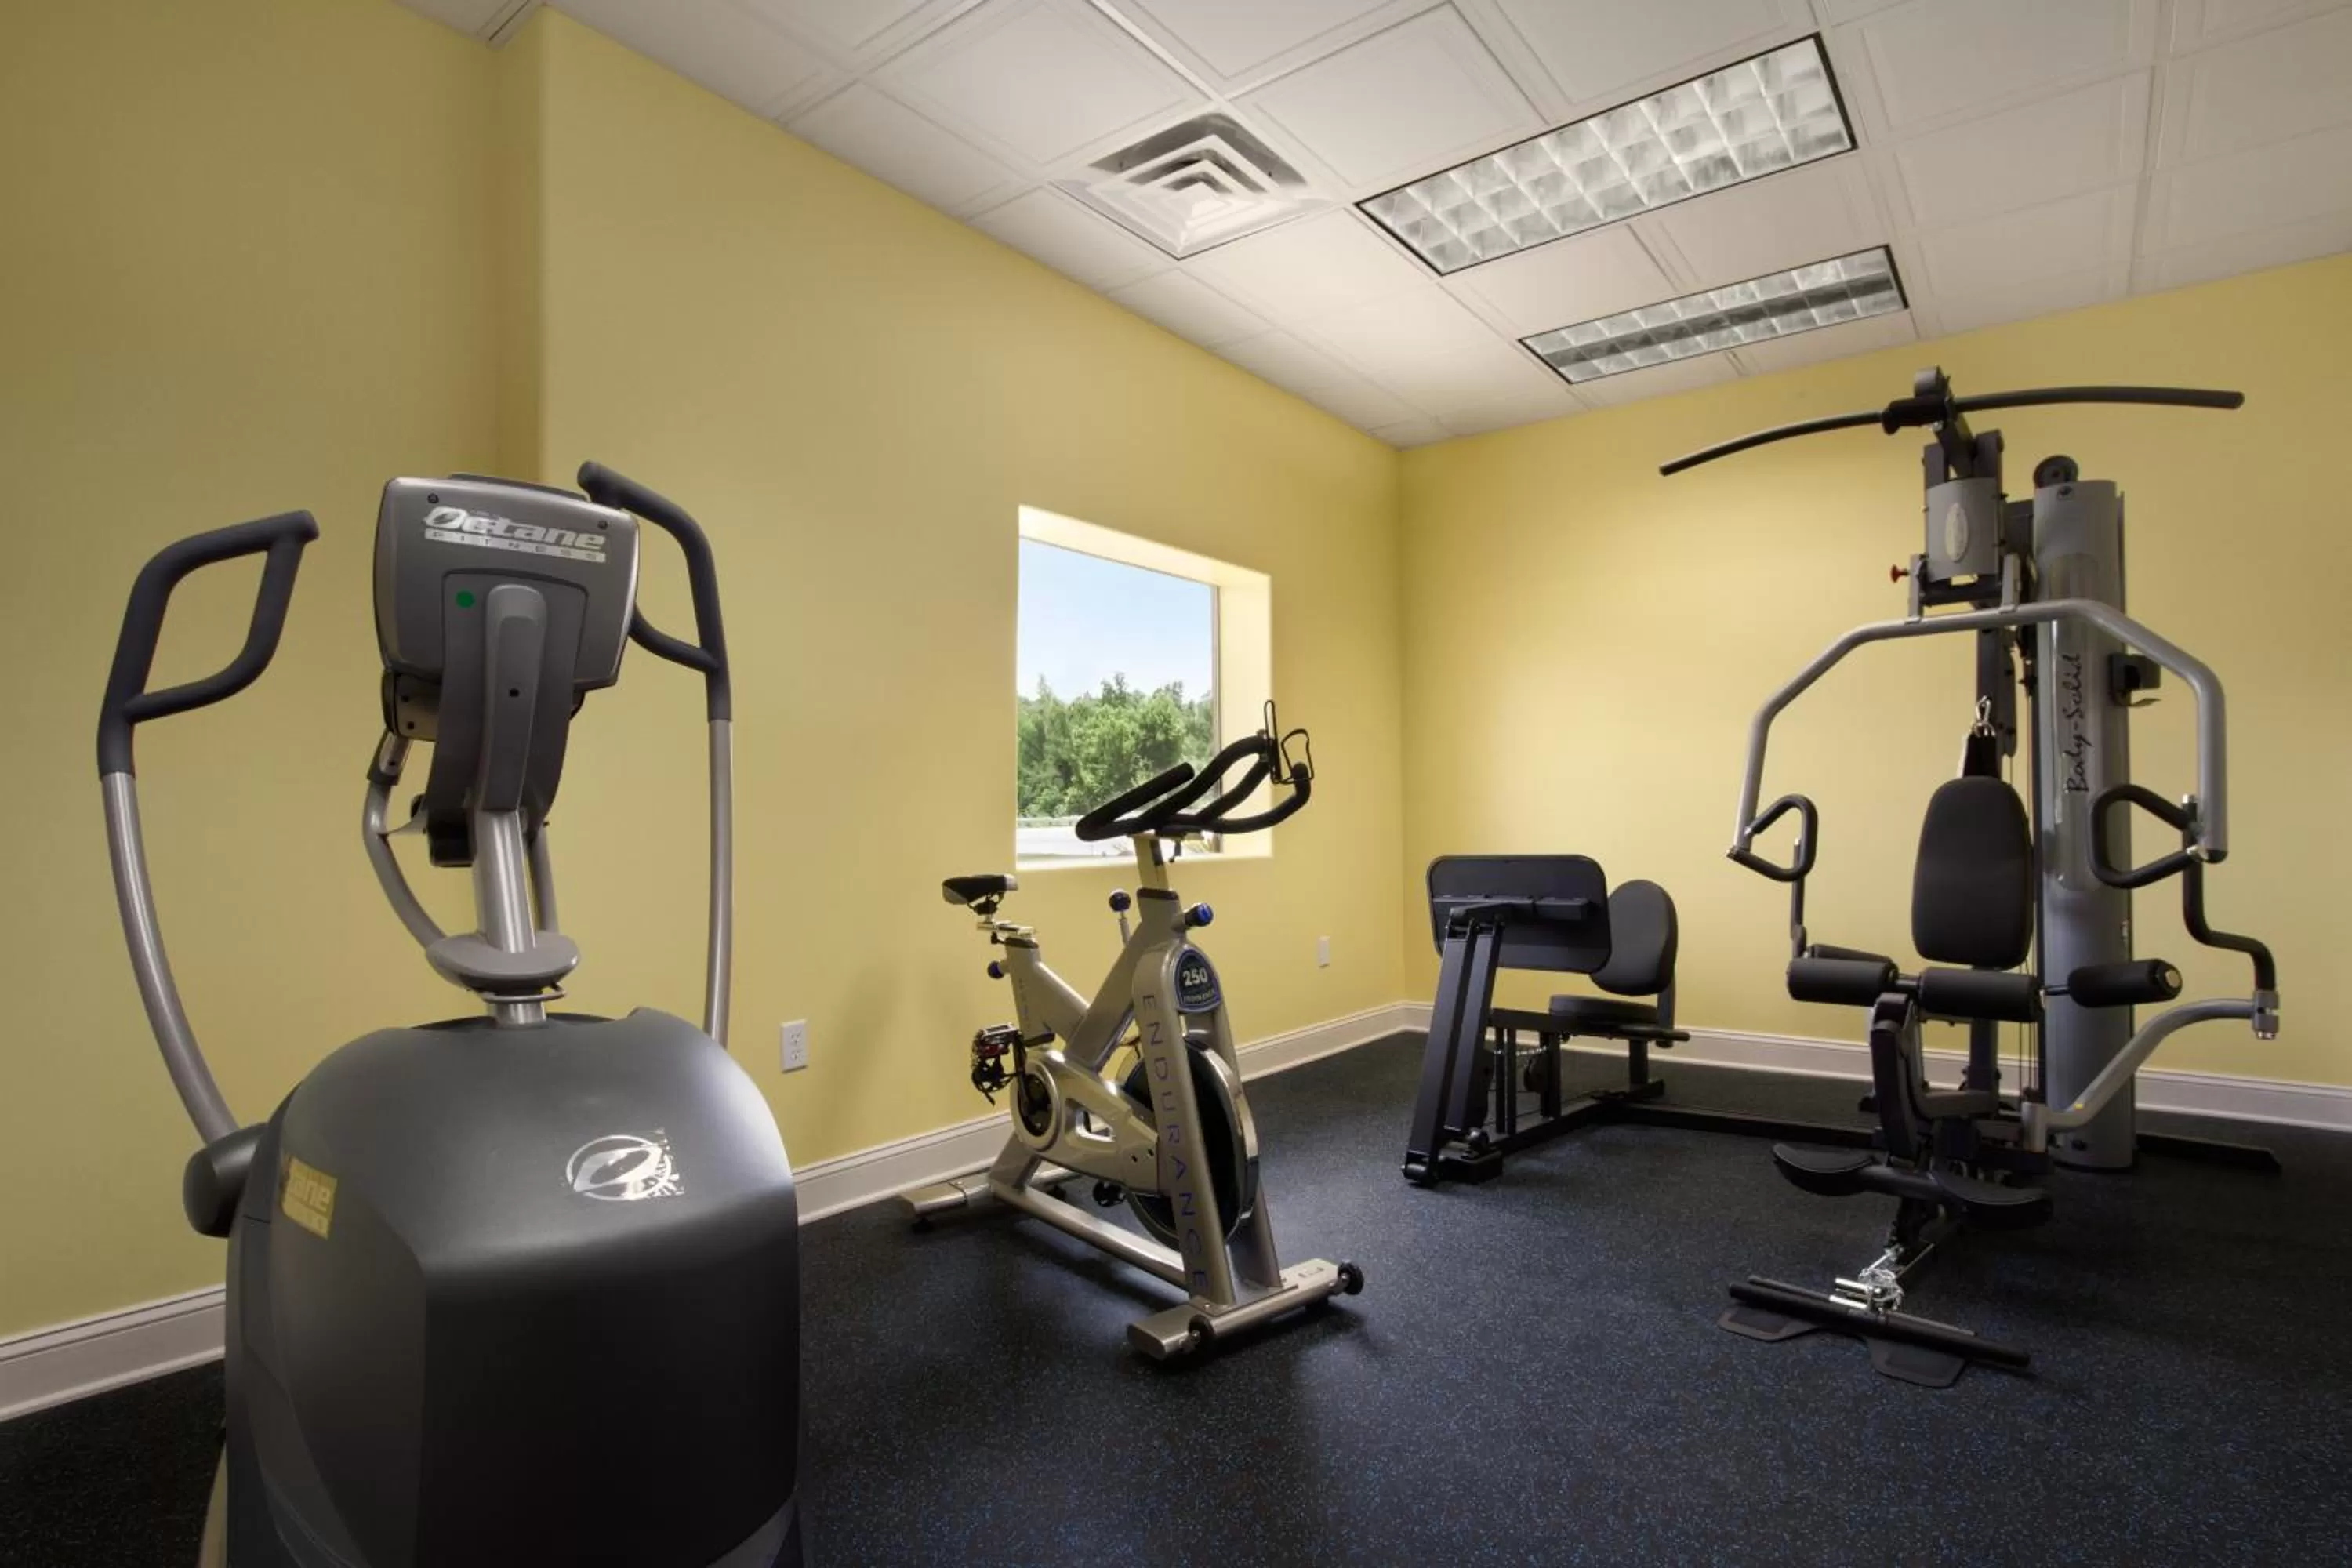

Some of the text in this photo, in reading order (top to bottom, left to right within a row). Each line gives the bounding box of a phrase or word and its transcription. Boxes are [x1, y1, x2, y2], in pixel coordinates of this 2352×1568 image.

[424, 506, 606, 550] Octane
[1182, 967, 1208, 986] 250
[1142, 994, 1208, 1289] ENDURANCE
